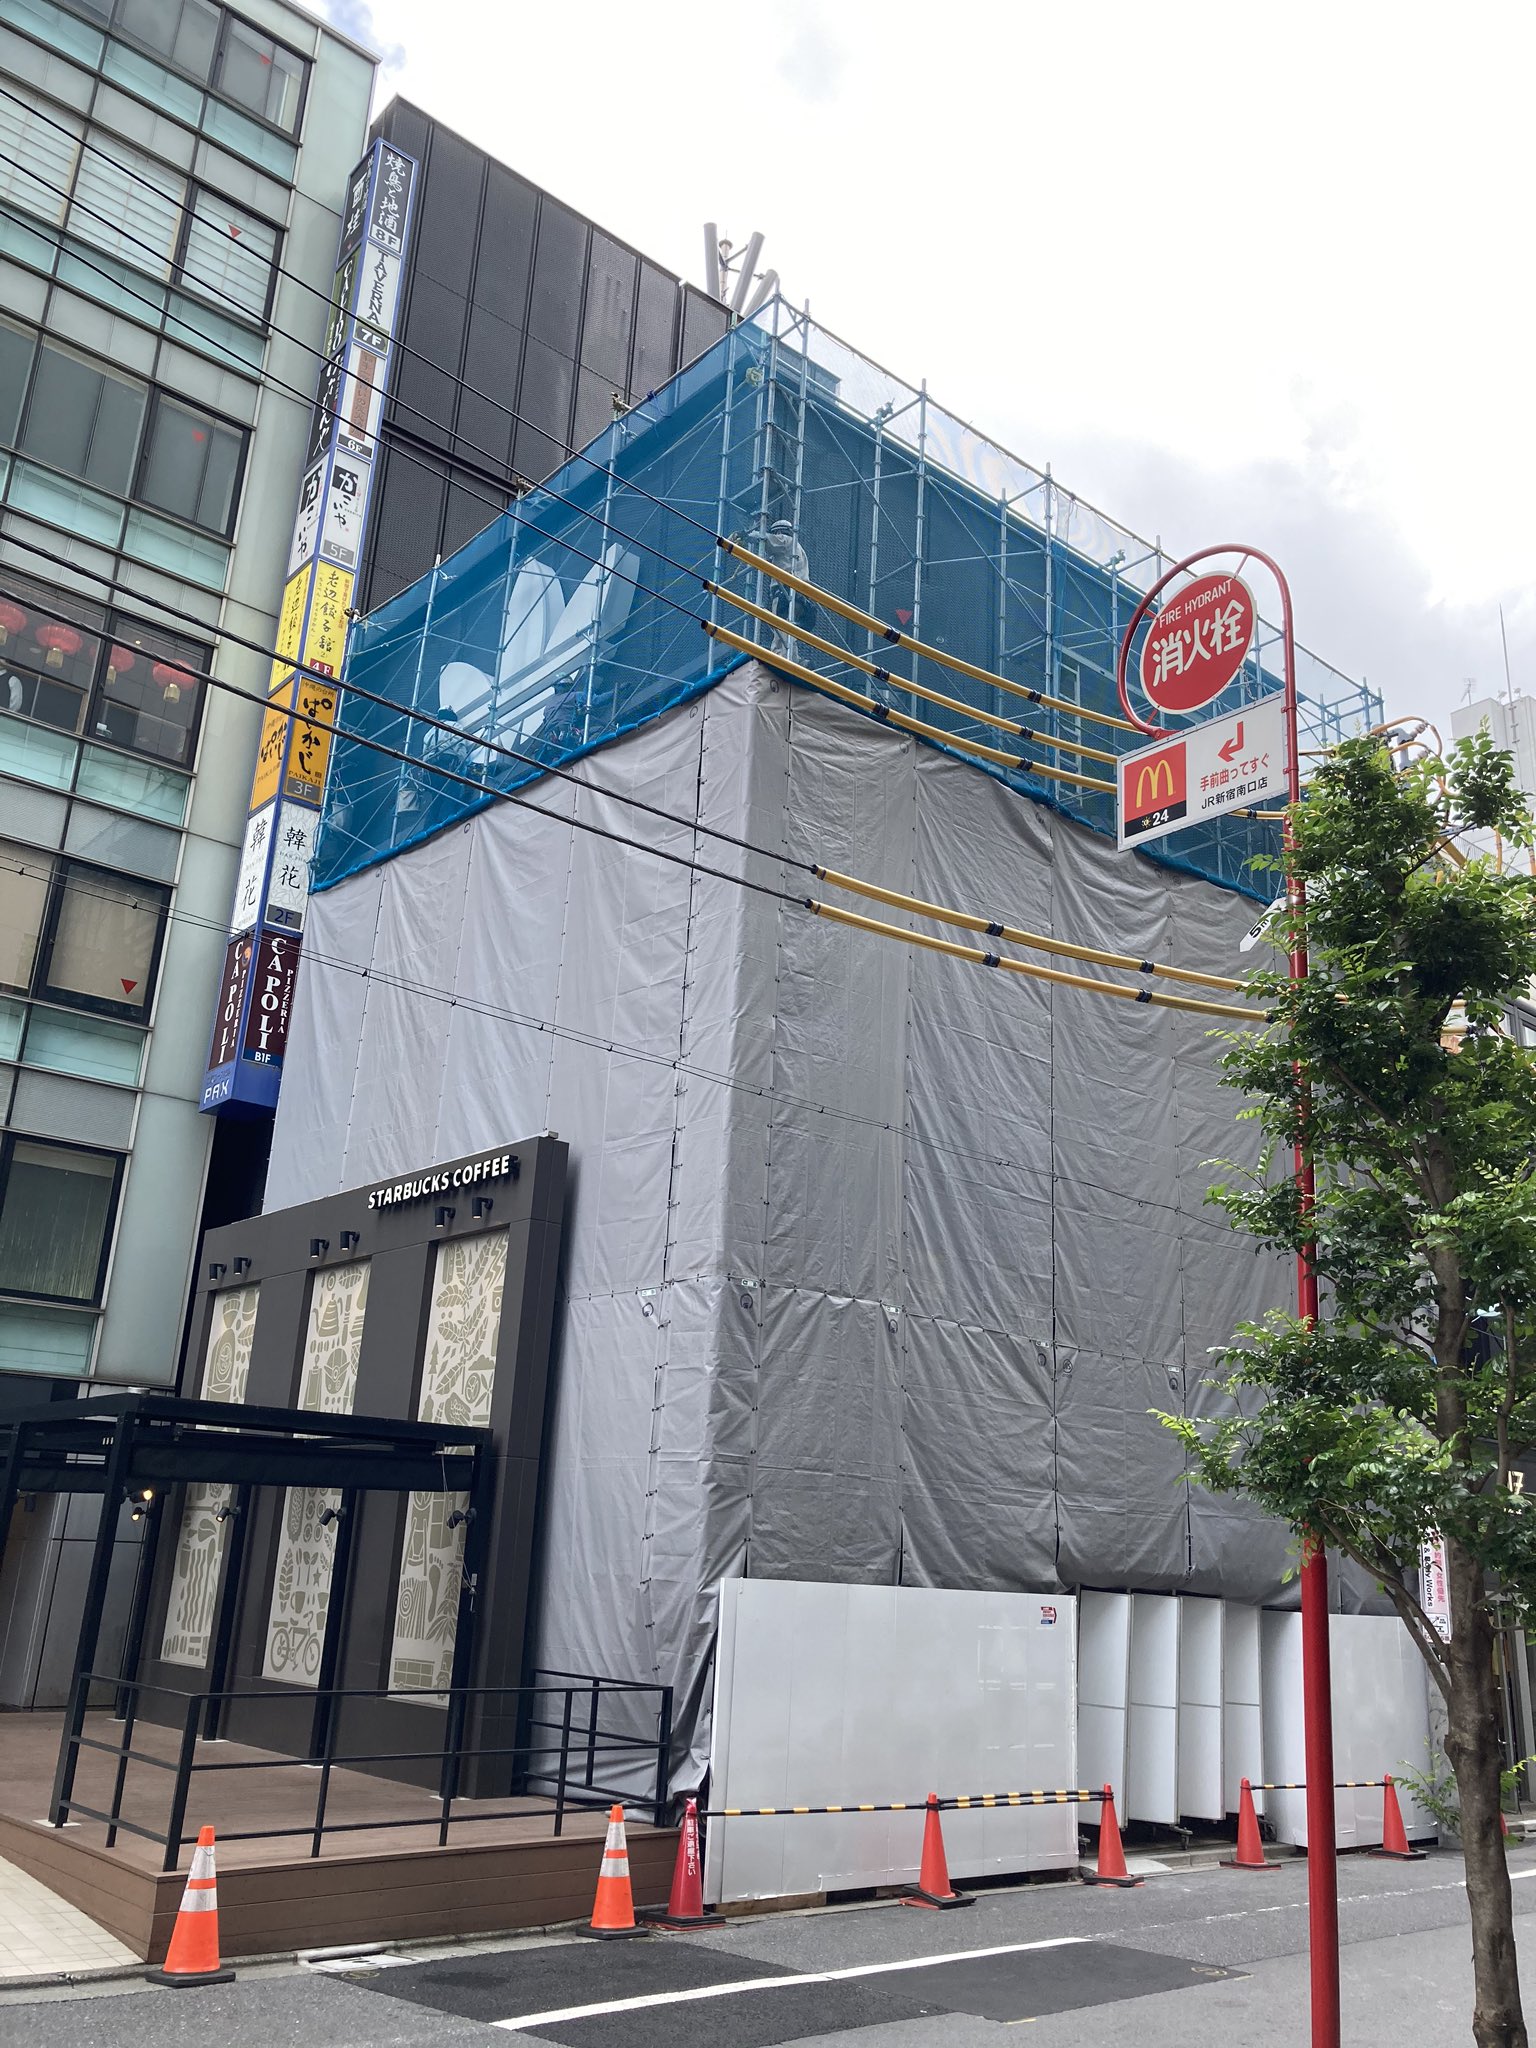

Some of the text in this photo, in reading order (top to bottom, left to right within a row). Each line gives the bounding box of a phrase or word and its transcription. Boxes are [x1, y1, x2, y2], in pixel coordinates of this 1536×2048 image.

[378, 152, 406, 233] 焼鳥と地酒
[375, 228, 397, 245] 8F
[367, 250, 389, 324] TAVERNA
[361, 328, 382, 346] 7F
[347, 439, 363, 451] 6F
[329, 544, 347, 559] 5F
[1159, 578, 1232, 628] FIRE HYDRANT
[1152, 599, 1245, 688] 消火栓
[312, 661, 331, 674] 4F
[288, 770, 321, 785] PAIKAJI
[294, 781, 312, 796] 3F
[1200, 752, 1270, 792] 手前曲ってすぐ
[1201, 776, 1268, 810] JR新宿南口店
[1152, 811, 1169, 827] 24
[243, 818, 268, 911] 韓花
[280, 826, 307, 889] 韓花
[274, 909, 294, 924] 2F
[218, 941, 244, 1064] CAPOLI
[230, 969, 247, 1048] PIZZERIA
[258, 937, 287, 1050] CAPOLI
[277, 968, 294, 1034] PIZZERIA
[254, 1051, 271, 1064] B1F
[203, 1079, 230, 1104] PAX
[367, 1154, 510, 1209] STARBUCKS COFFEE
[1426, 1579, 1434, 1607] Works
